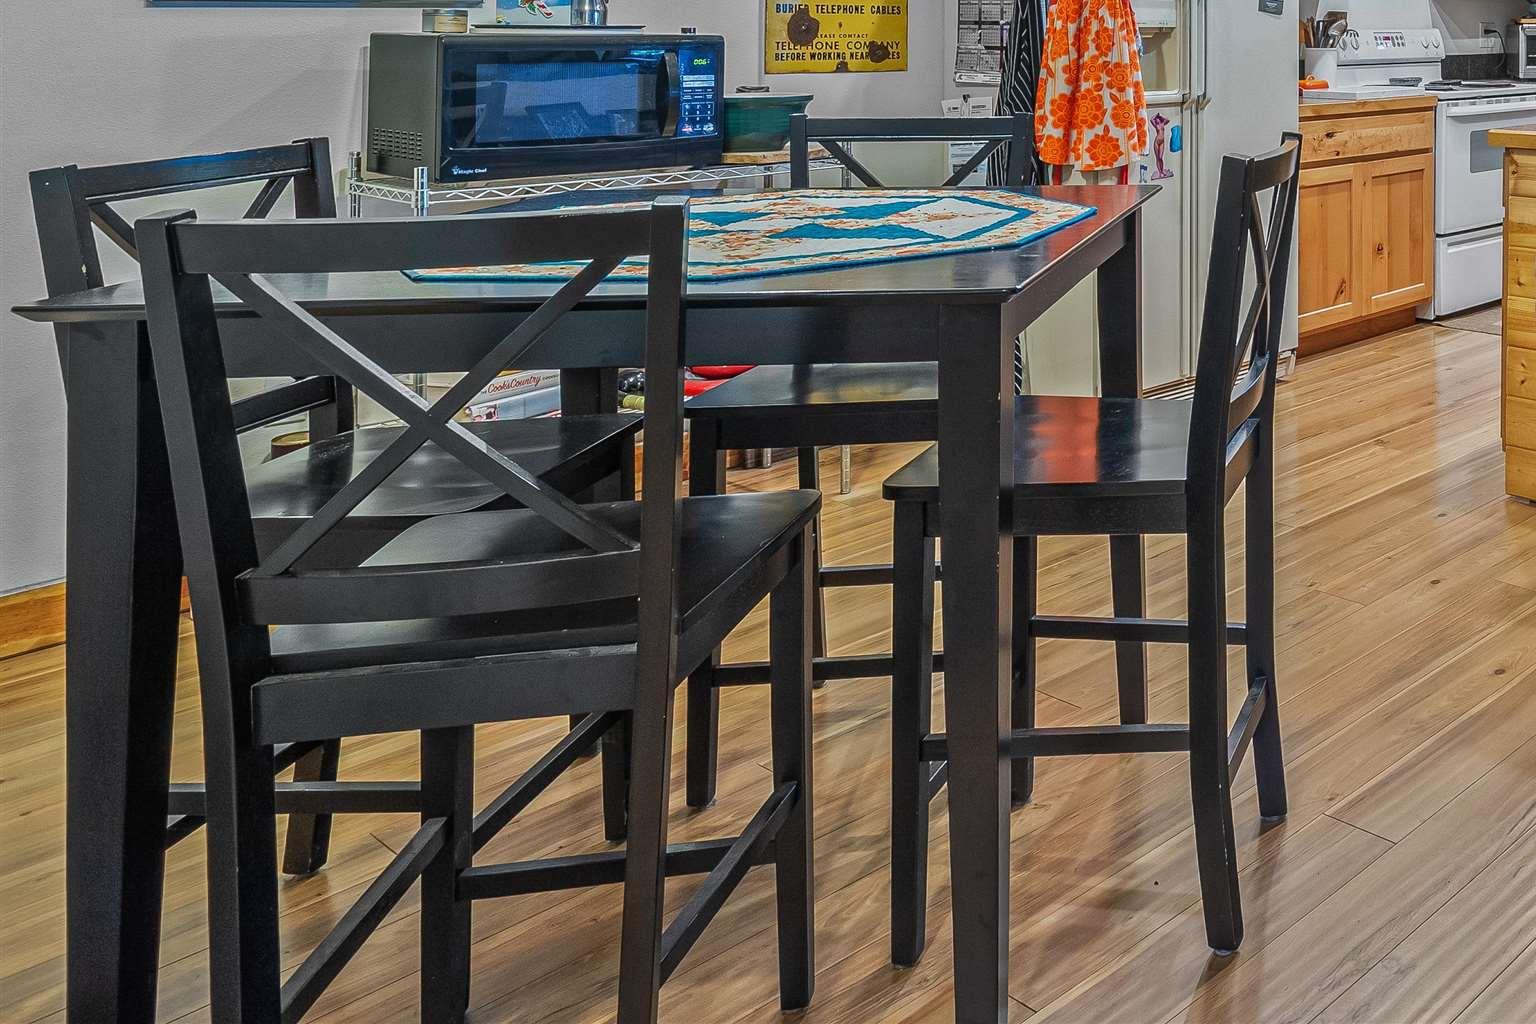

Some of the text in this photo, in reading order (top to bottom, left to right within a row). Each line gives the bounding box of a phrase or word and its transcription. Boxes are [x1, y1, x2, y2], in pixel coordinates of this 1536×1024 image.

[816, 4, 865, 14] TELEPHONE
[870, 5, 901, 15] CABLES
[847, 41, 900, 50] COMANY
[775, 53, 806, 61] BEFORE
[810, 52, 846, 60] WORKING
[850, 52, 870, 60] NEAR
